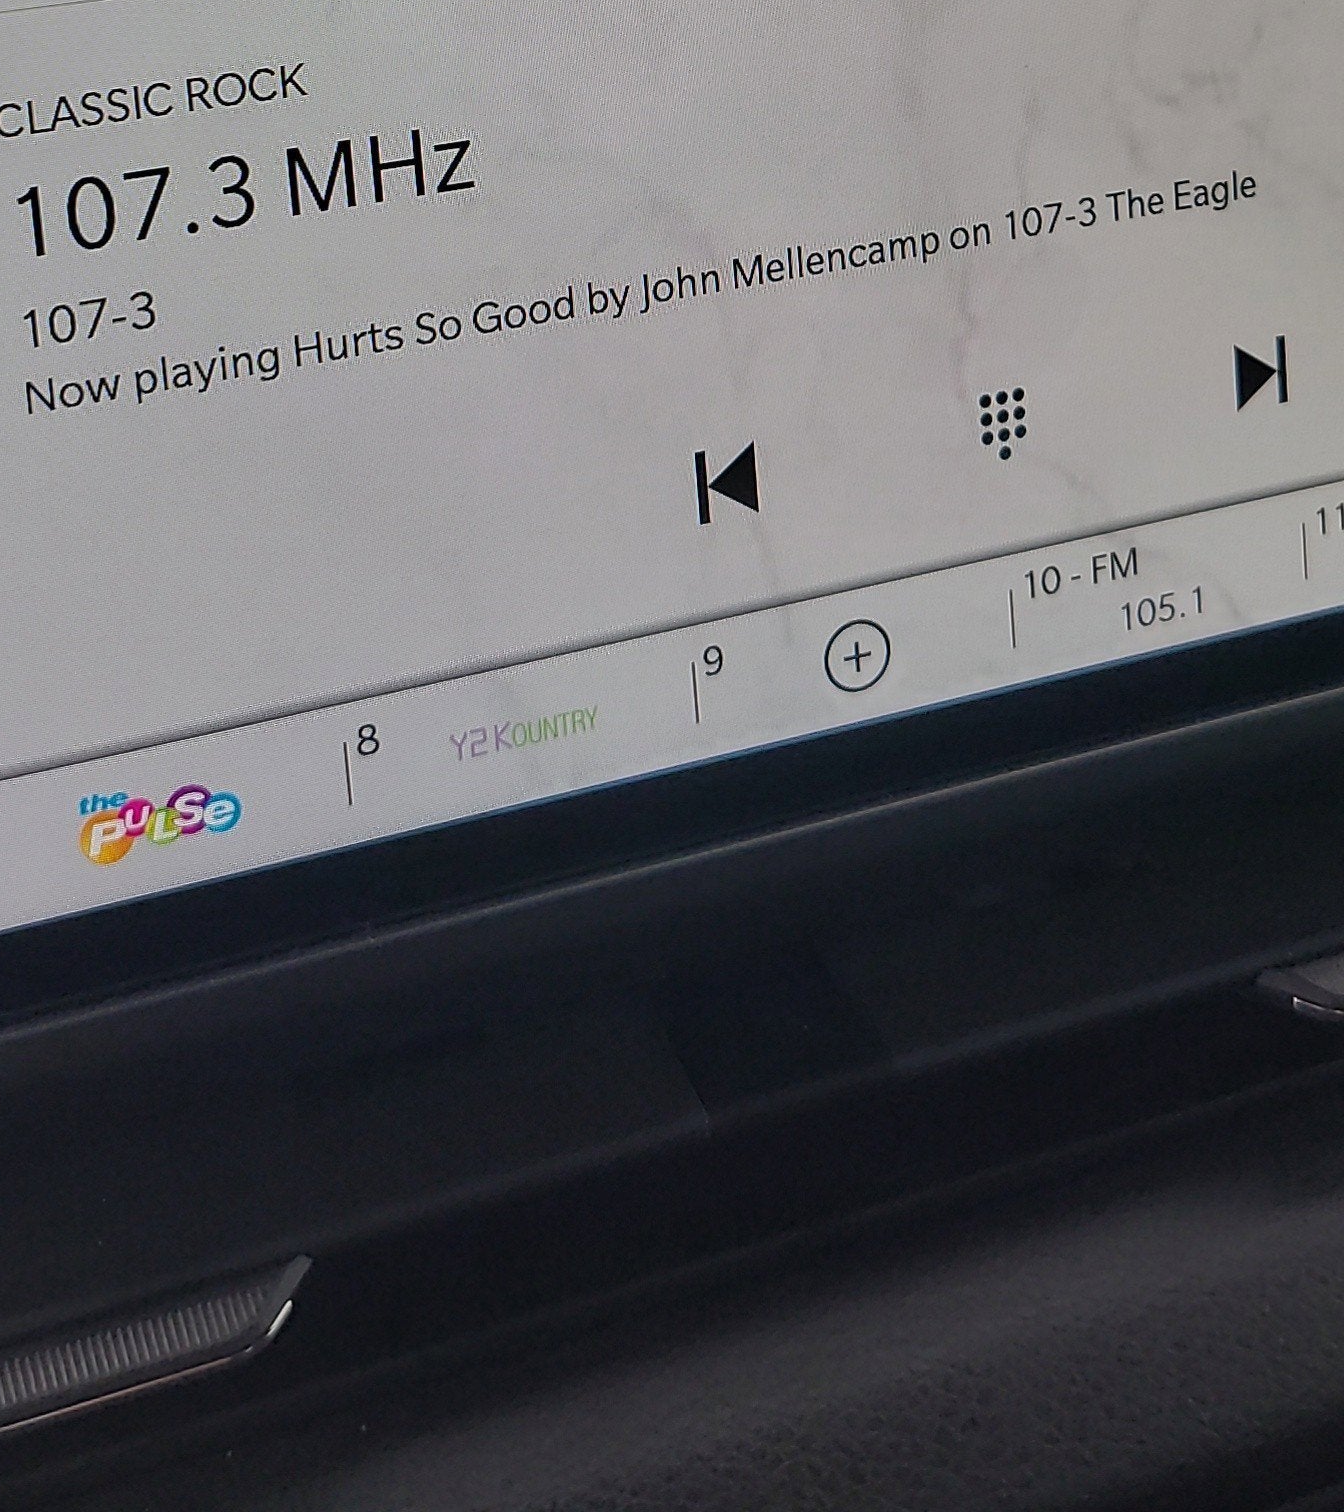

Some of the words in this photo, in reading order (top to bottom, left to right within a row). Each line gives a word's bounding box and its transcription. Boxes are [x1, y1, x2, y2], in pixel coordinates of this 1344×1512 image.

[186, 62, 309, 112] ROCK
[16, 155, 257, 257] 107.3
[286, 129, 476, 217] MHz
[25, 376, 120, 414] Now
[135, 344, 280, 404] playing
[294, 321, 404, 367] Hurts
[415, 311, 461, 346] So
[472, 285, 575, 336] Good
[586, 276, 629, 322] by
[639, 264, 721, 314] John
[731, 229, 940, 290] Mellencamp
[949, 222, 990, 250] on
[1004, 197, 1097, 240] 107-3
[1105, 188, 1164, 222] The
[1172, 170, 1258, 212] Eagle
[22, 291, 157, 348] 107-3
[1024, 566, 1061, 598] 10
[1092, 547, 1138, 584] FM
[1121, 586, 1203, 630] 105.1
[702, 644, 725, 678] 9
[356, 723, 381, 757] 8
[78, 790, 129, 817] the
